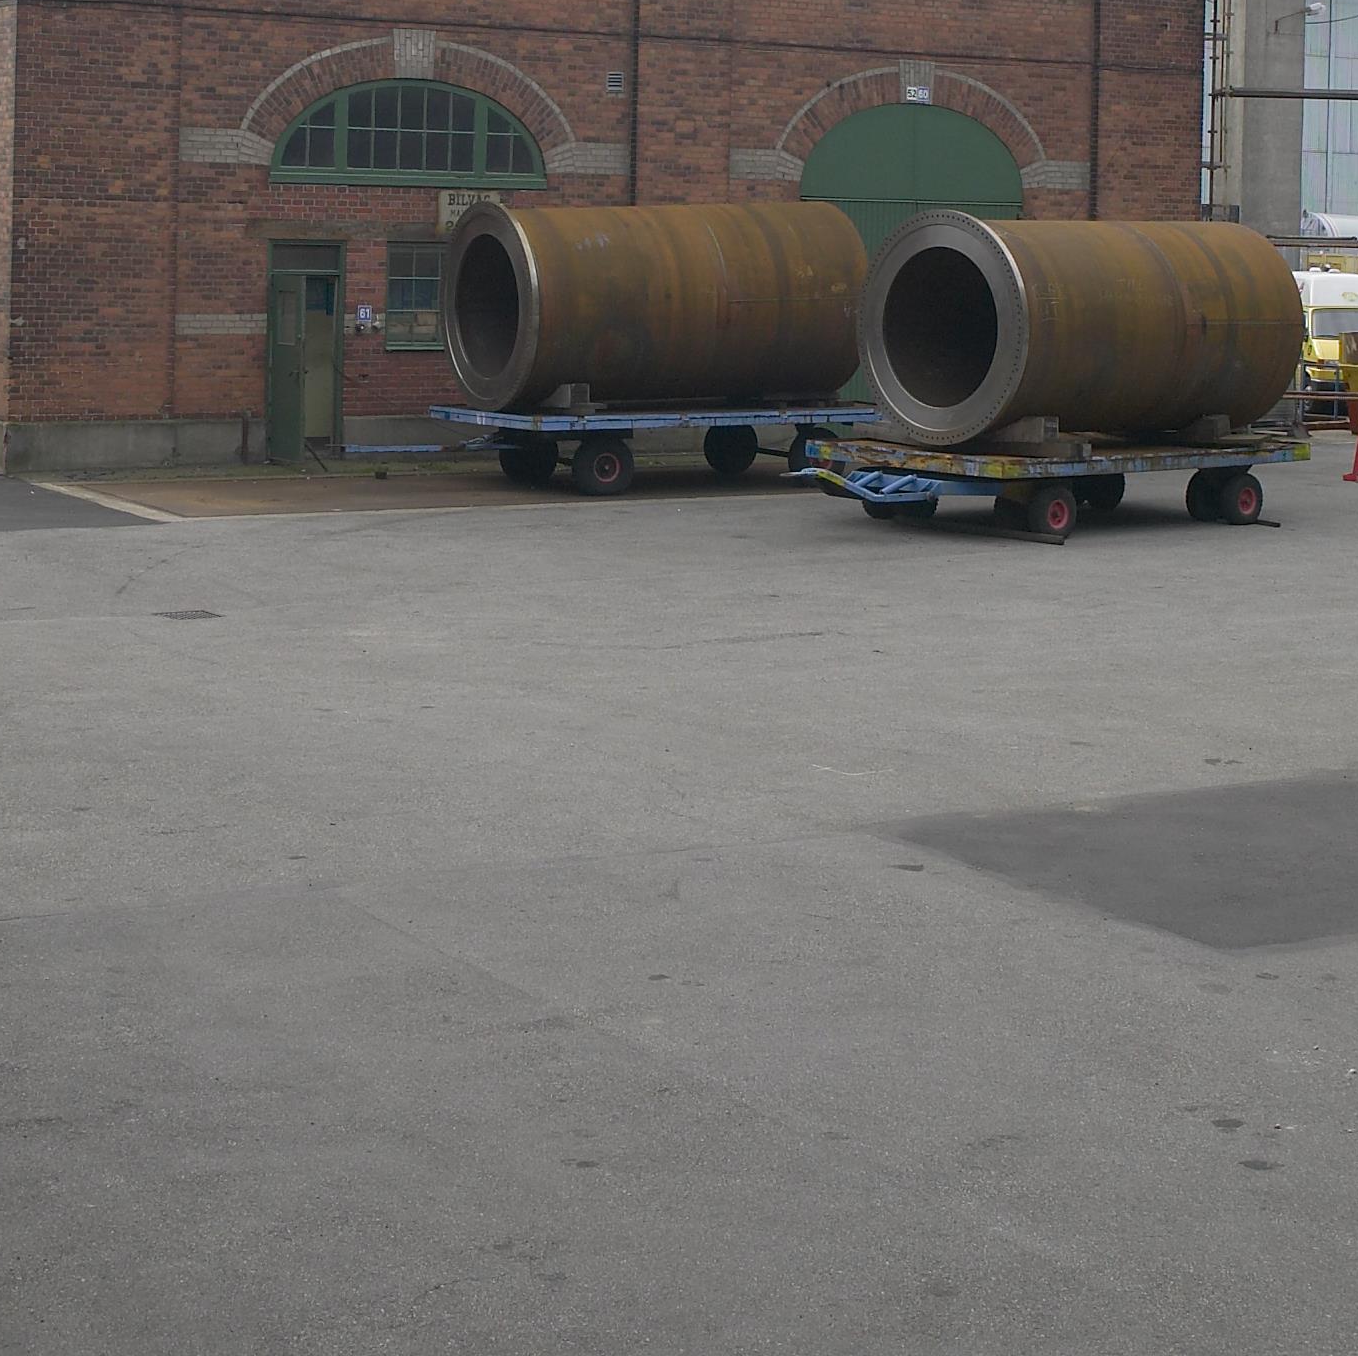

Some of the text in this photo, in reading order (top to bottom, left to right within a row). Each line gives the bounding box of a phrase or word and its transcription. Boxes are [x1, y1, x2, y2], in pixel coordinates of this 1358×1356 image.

[907, 89, 917, 98] 52
[919, 89, 929, 99] 60
[359, 308, 370, 319] 61
